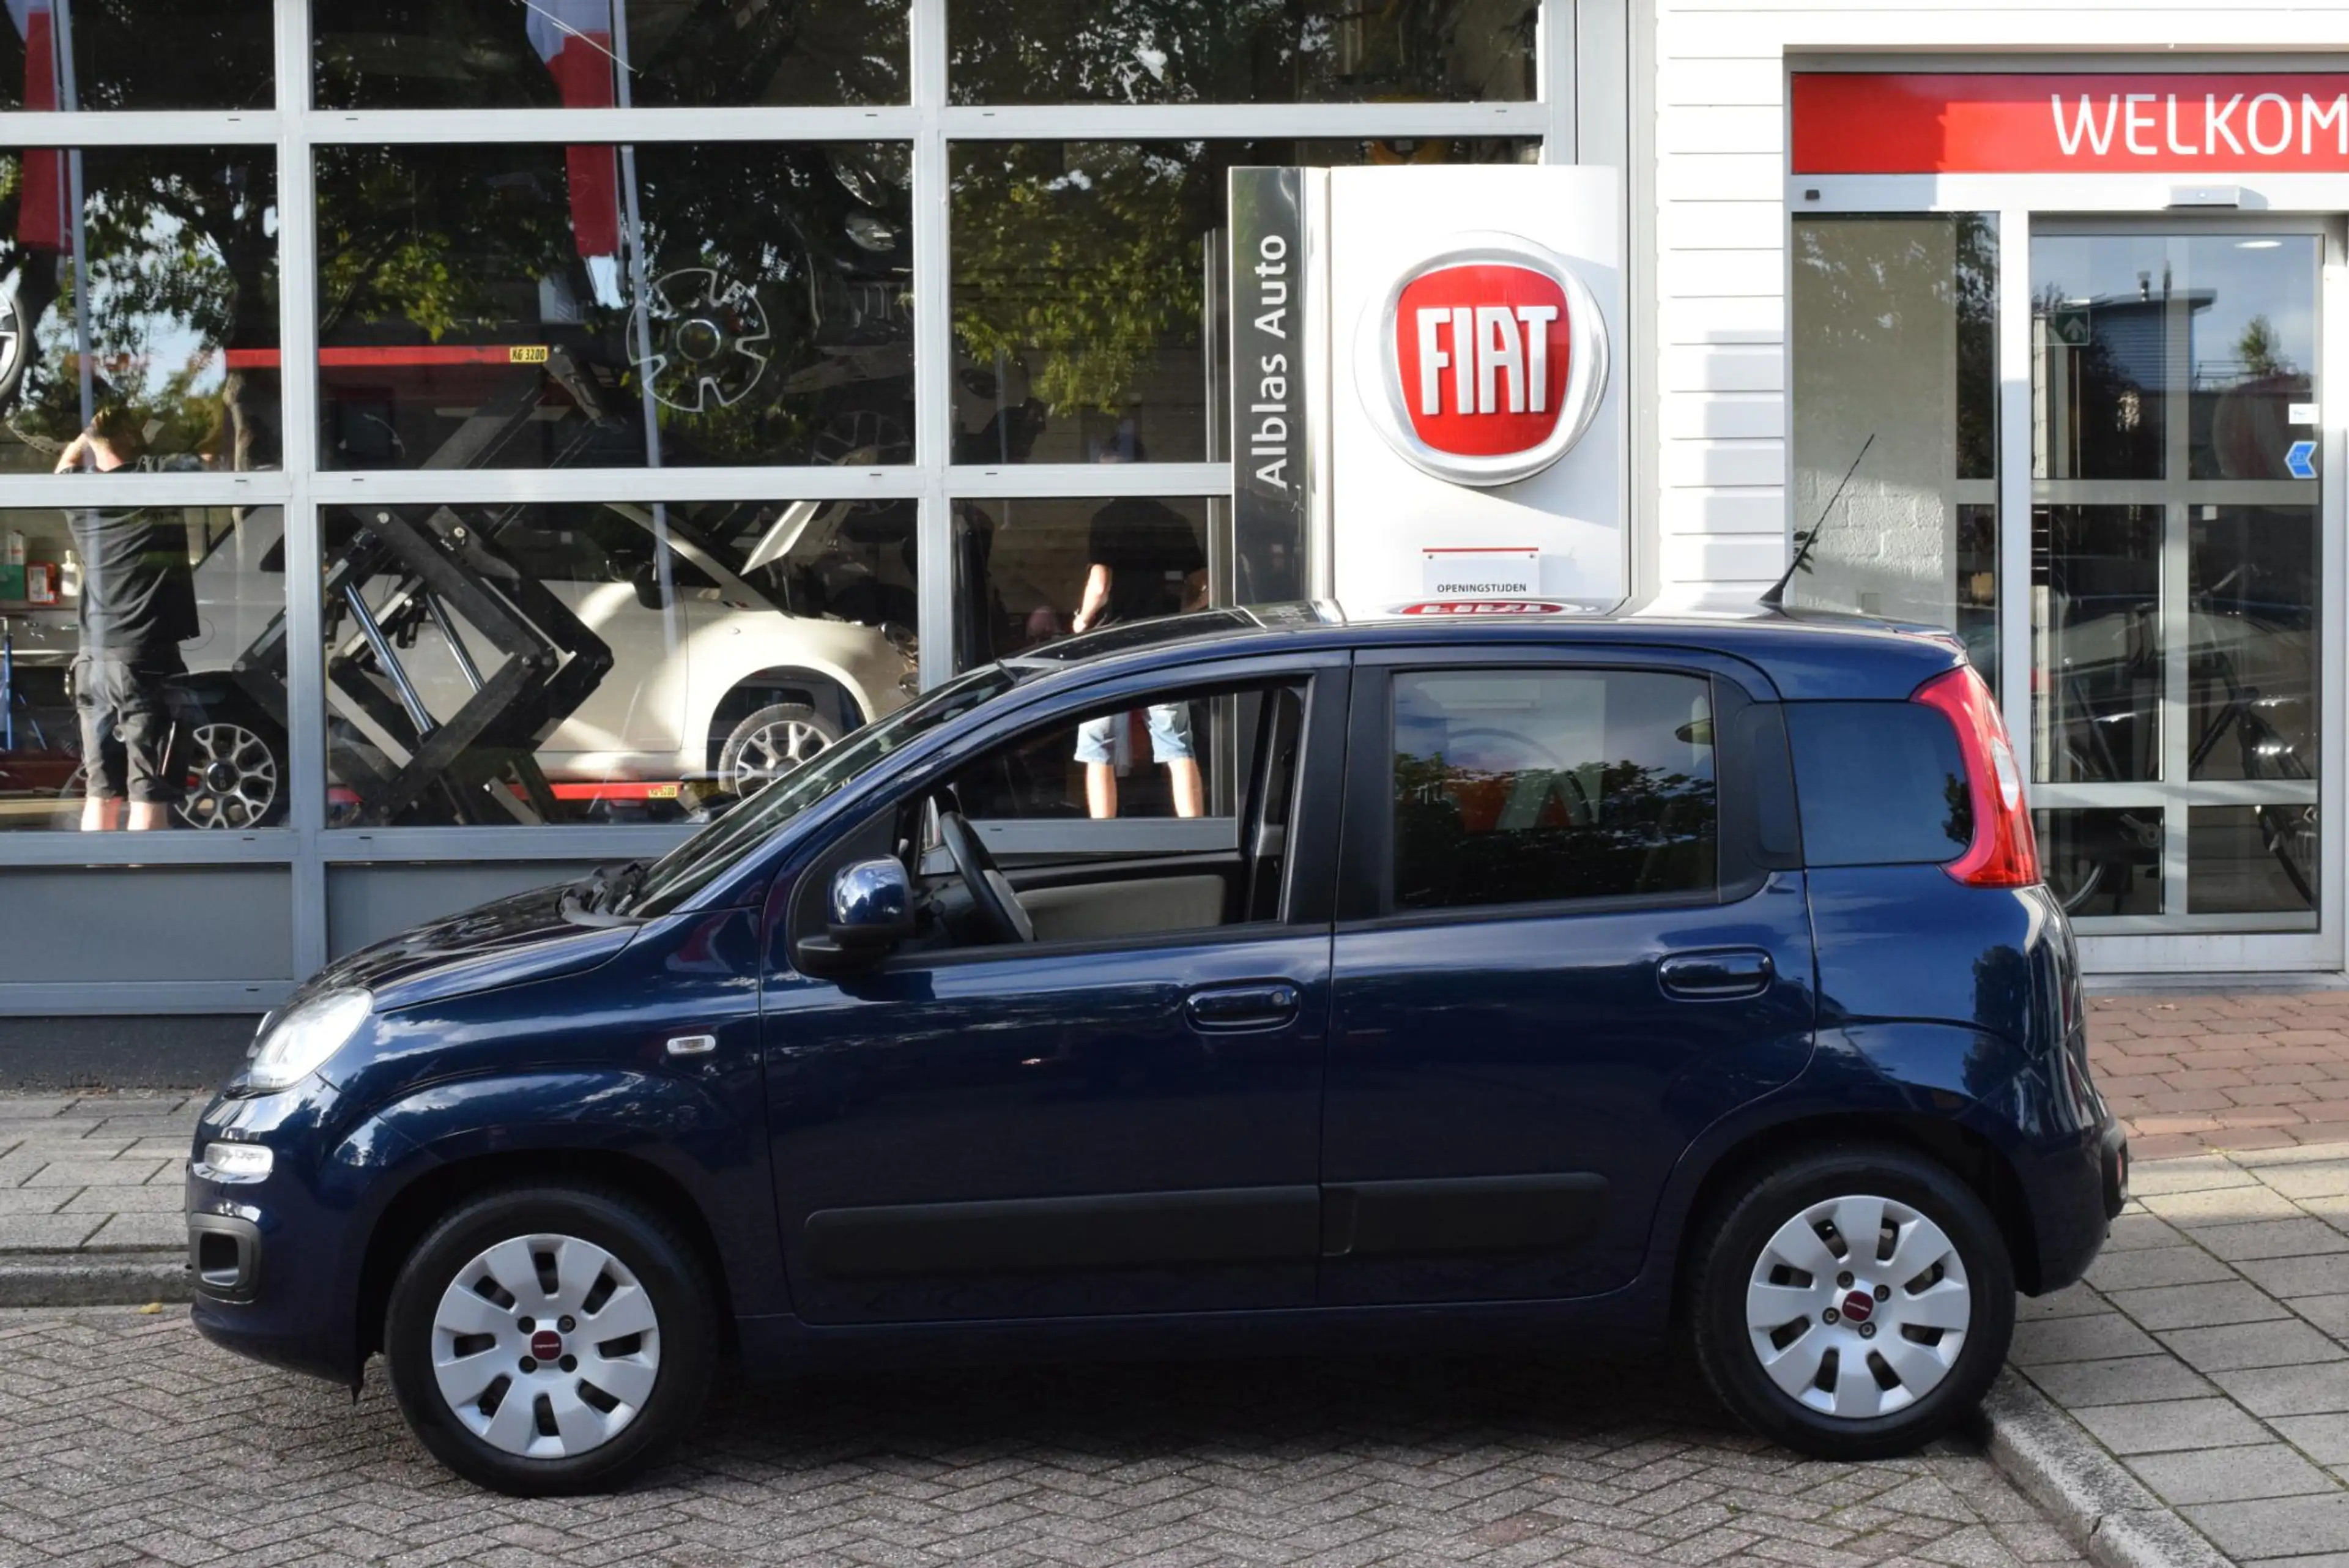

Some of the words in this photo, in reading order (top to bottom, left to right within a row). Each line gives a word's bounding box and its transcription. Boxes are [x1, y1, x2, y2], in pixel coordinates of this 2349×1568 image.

[2051, 93, 2348, 155] WELKOM
[1254, 234, 1287, 339] Auto
[525, 348, 546, 360] 3200
[1417, 305, 1558, 415] FIAT
[1252, 353, 1288, 489] Alblas
[1437, 583, 1527, 593] OPENINGSTIJDEN
